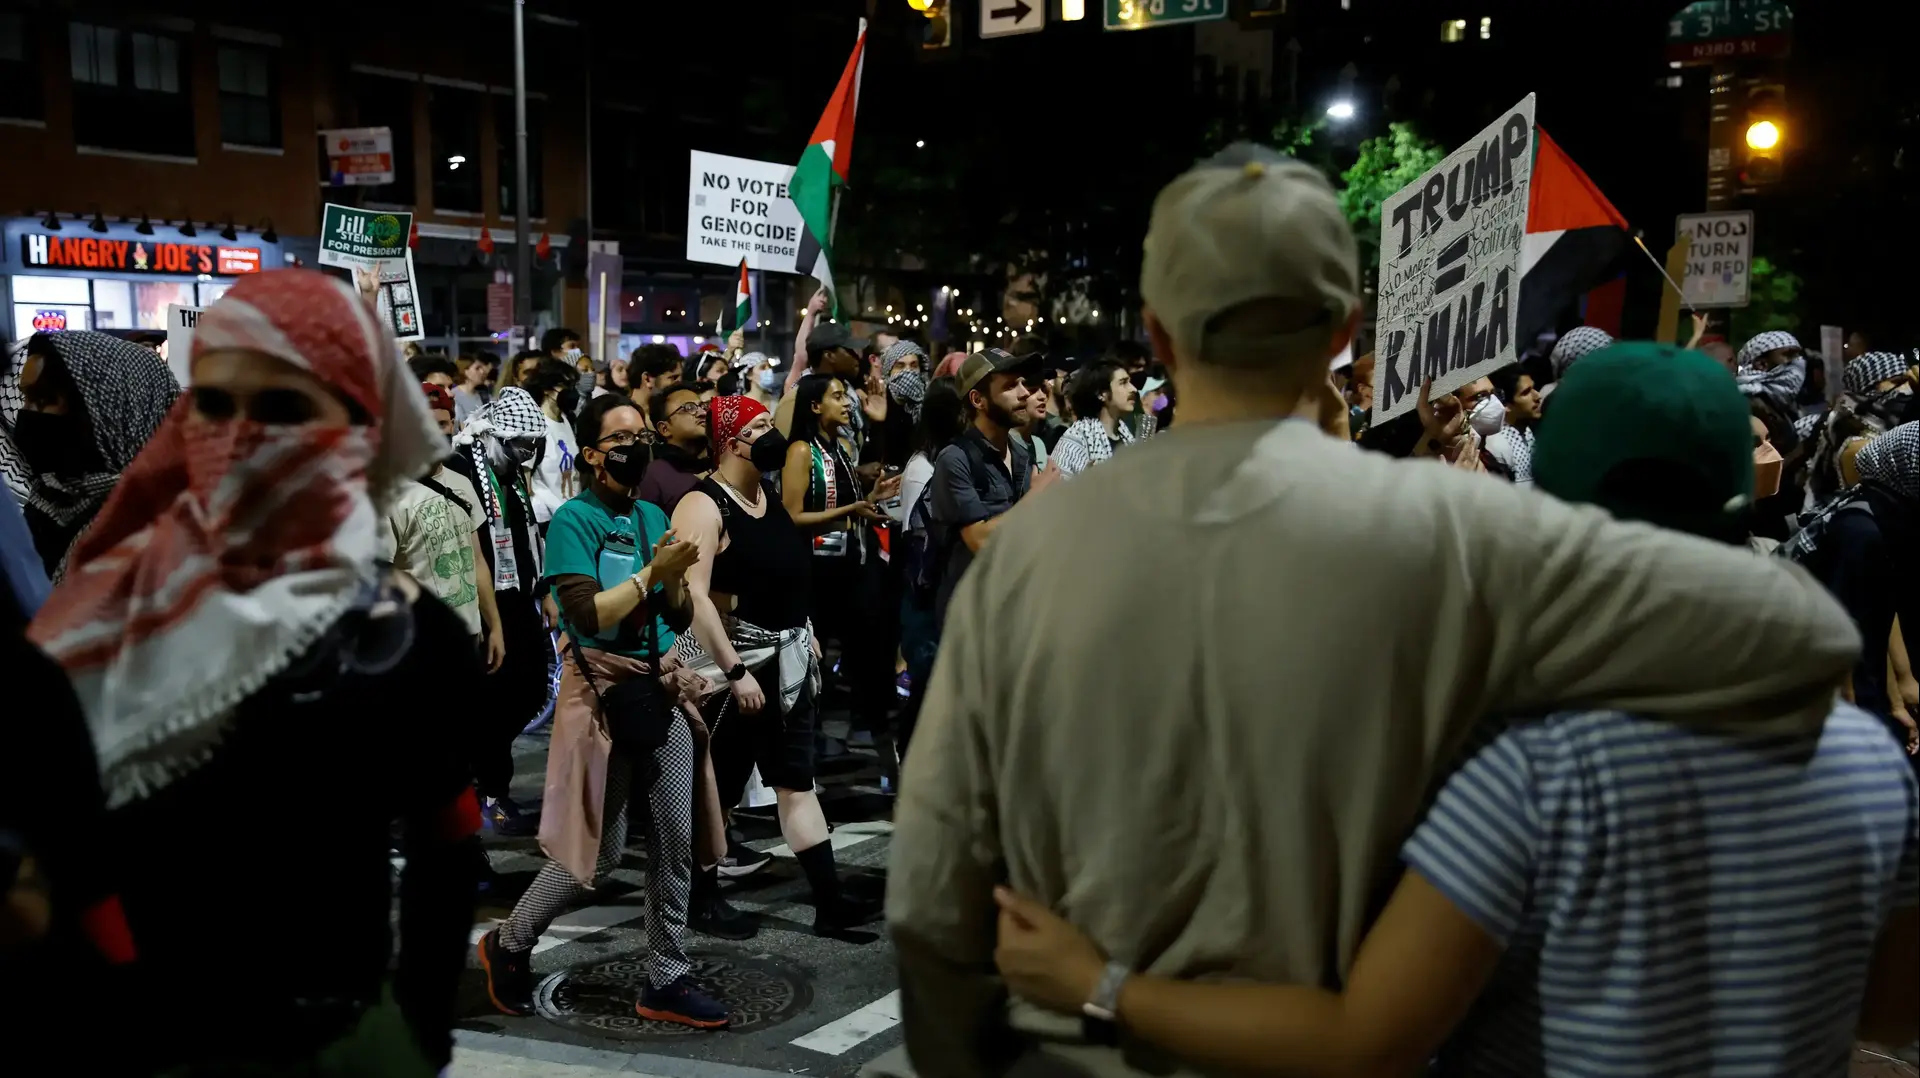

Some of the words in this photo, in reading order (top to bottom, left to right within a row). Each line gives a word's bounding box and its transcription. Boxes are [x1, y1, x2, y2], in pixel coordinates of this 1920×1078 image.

[1755, 10, 1781, 31] St
[703, 172, 730, 190] NO
[737, 177, 792, 200] VOTE
[1391, 112, 1528, 260] TRUMP
[731, 198, 769, 218] FOR
[336, 214, 365, 235] Jill
[701, 215, 796, 242] GENOCIDE
[1697, 220, 1731, 239] NO
[340, 230, 373, 244] STEIN
[701, 235, 727, 248] TAKE
[731, 240, 751, 251] THE
[754, 244, 795, 257] PLEDGE
[28, 234, 128, 269] HANGRY
[153, 242, 213, 273] JOE'S
[328, 240, 351, 252] FOR
[353, 245, 403, 257] PRESIDENT
[1690, 241, 1739, 258] TURN
[1712, 260, 1744, 275] RED
[1382, 266, 1509, 412] KAMALA
